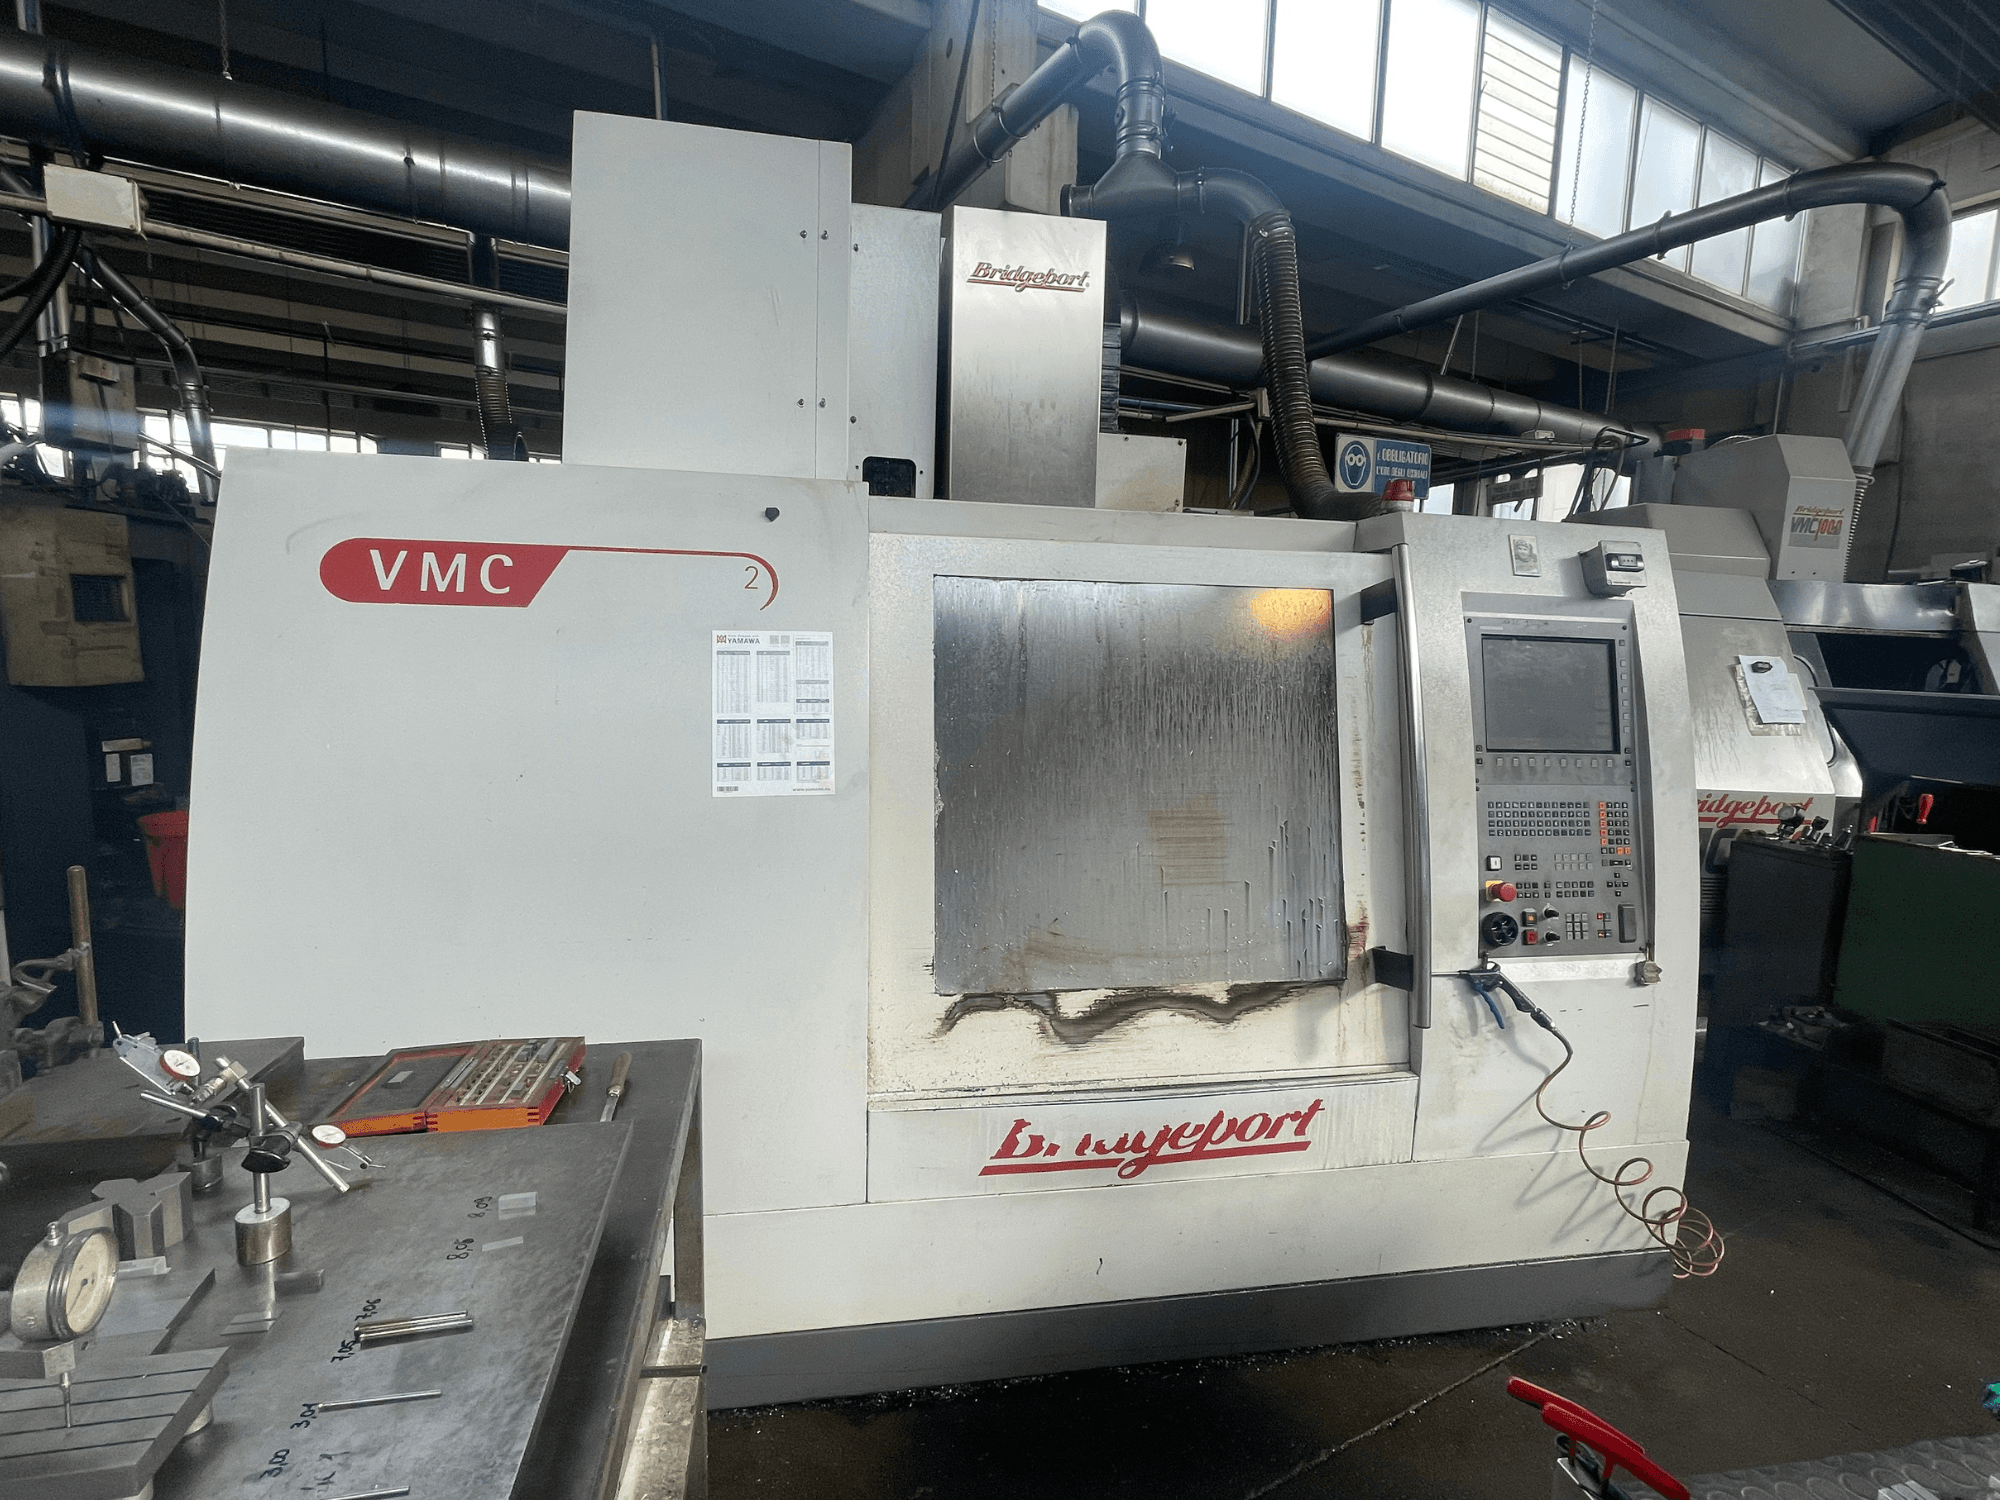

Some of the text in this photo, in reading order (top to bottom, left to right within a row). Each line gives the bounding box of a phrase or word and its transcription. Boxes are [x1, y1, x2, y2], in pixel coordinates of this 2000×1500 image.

[969, 261, 1090, 293] Bridgeport
[1382, 448, 1429, 466] OBBLIGATORIO
[369, 548, 515, 595] VMC
[743, 565, 760, 591] 2
[727, 637, 761, 645] YAMAWA
[1697, 793, 1815, 829] idgepot
